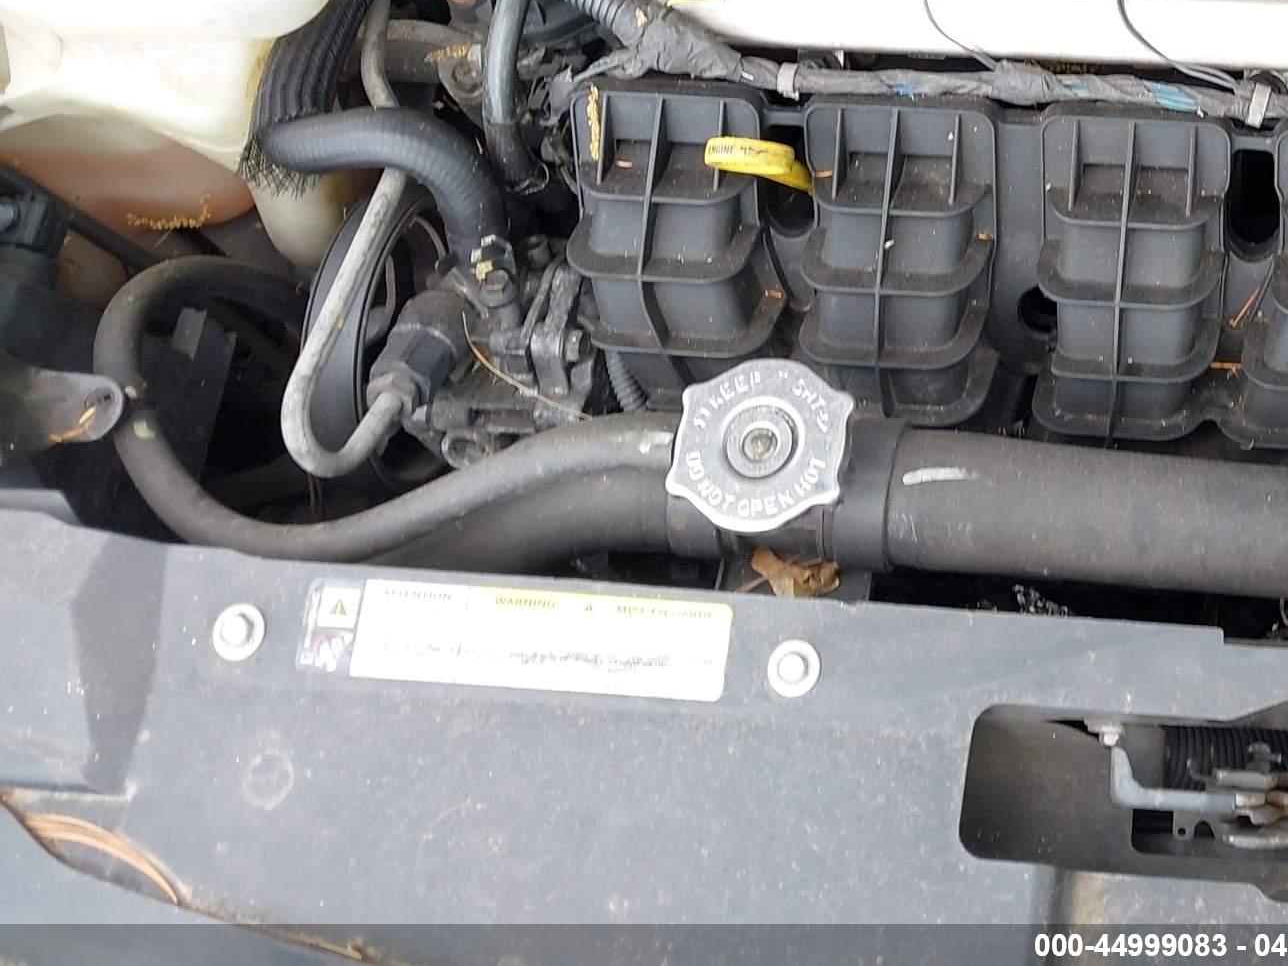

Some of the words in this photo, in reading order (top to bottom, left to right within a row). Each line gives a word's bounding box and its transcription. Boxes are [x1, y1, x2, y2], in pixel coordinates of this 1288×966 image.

[708, 371, 761, 409] KEEP
[686, 451, 706, 480] DO
[697, 479, 735, 512] NOT
[737, 489, 795, 517] OPEN
[794, 457, 826, 497] HOT
[495, 595, 557, 609] WARNING
